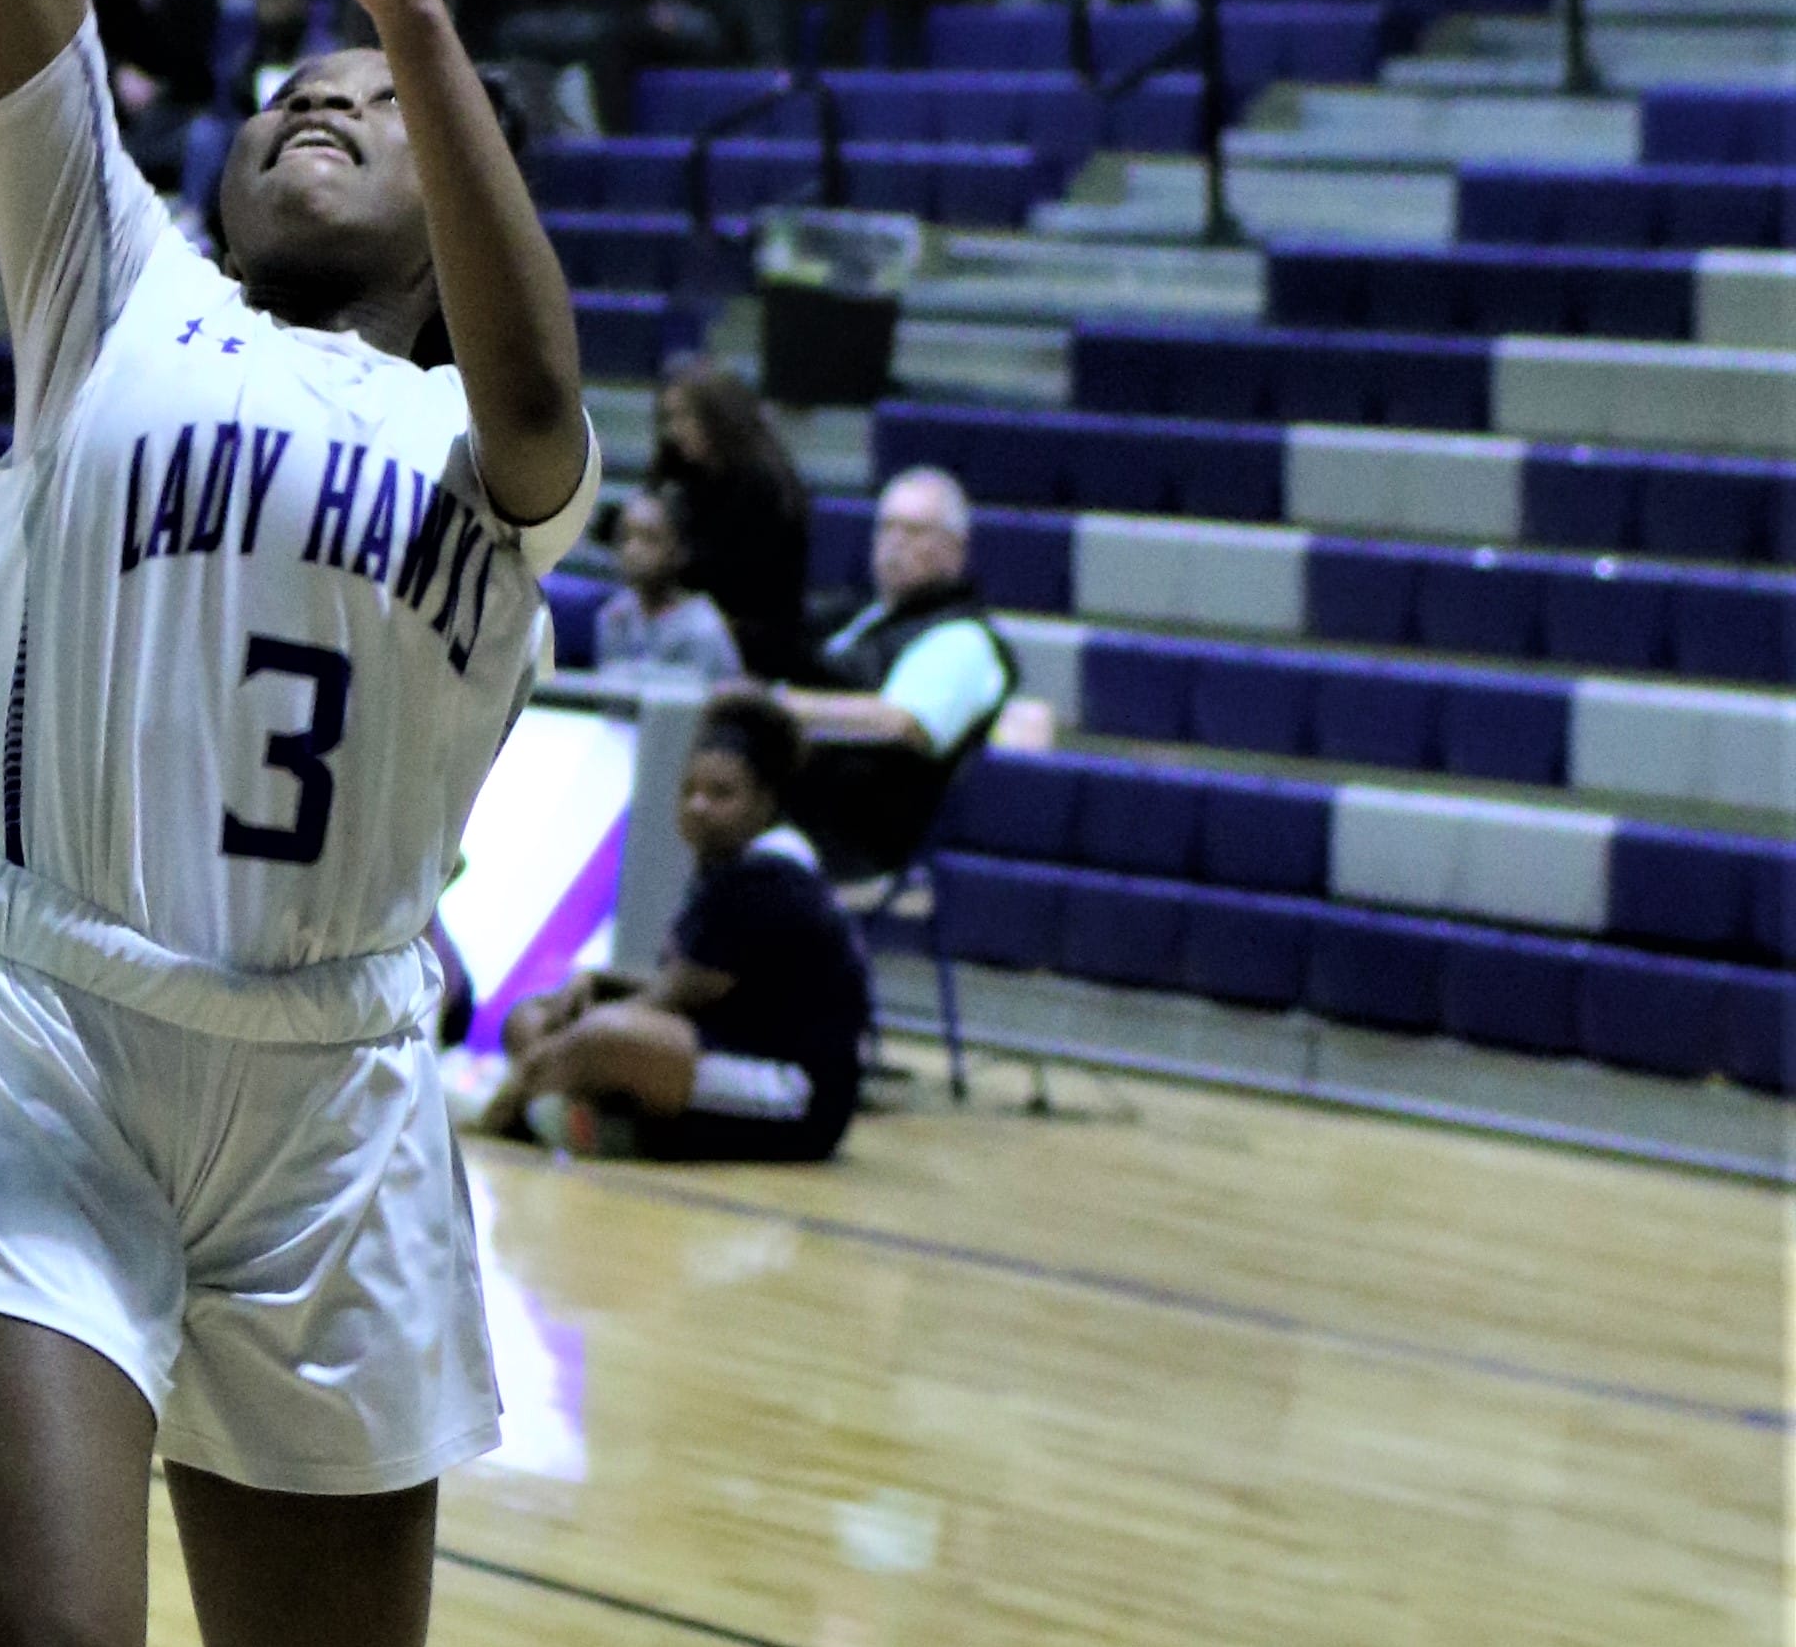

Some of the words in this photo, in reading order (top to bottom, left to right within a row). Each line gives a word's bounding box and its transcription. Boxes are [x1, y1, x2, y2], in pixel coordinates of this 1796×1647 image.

[120, 420, 293, 575] LADY
[301, 439, 496, 676] HAWKS
[219, 632, 352, 866] 3
